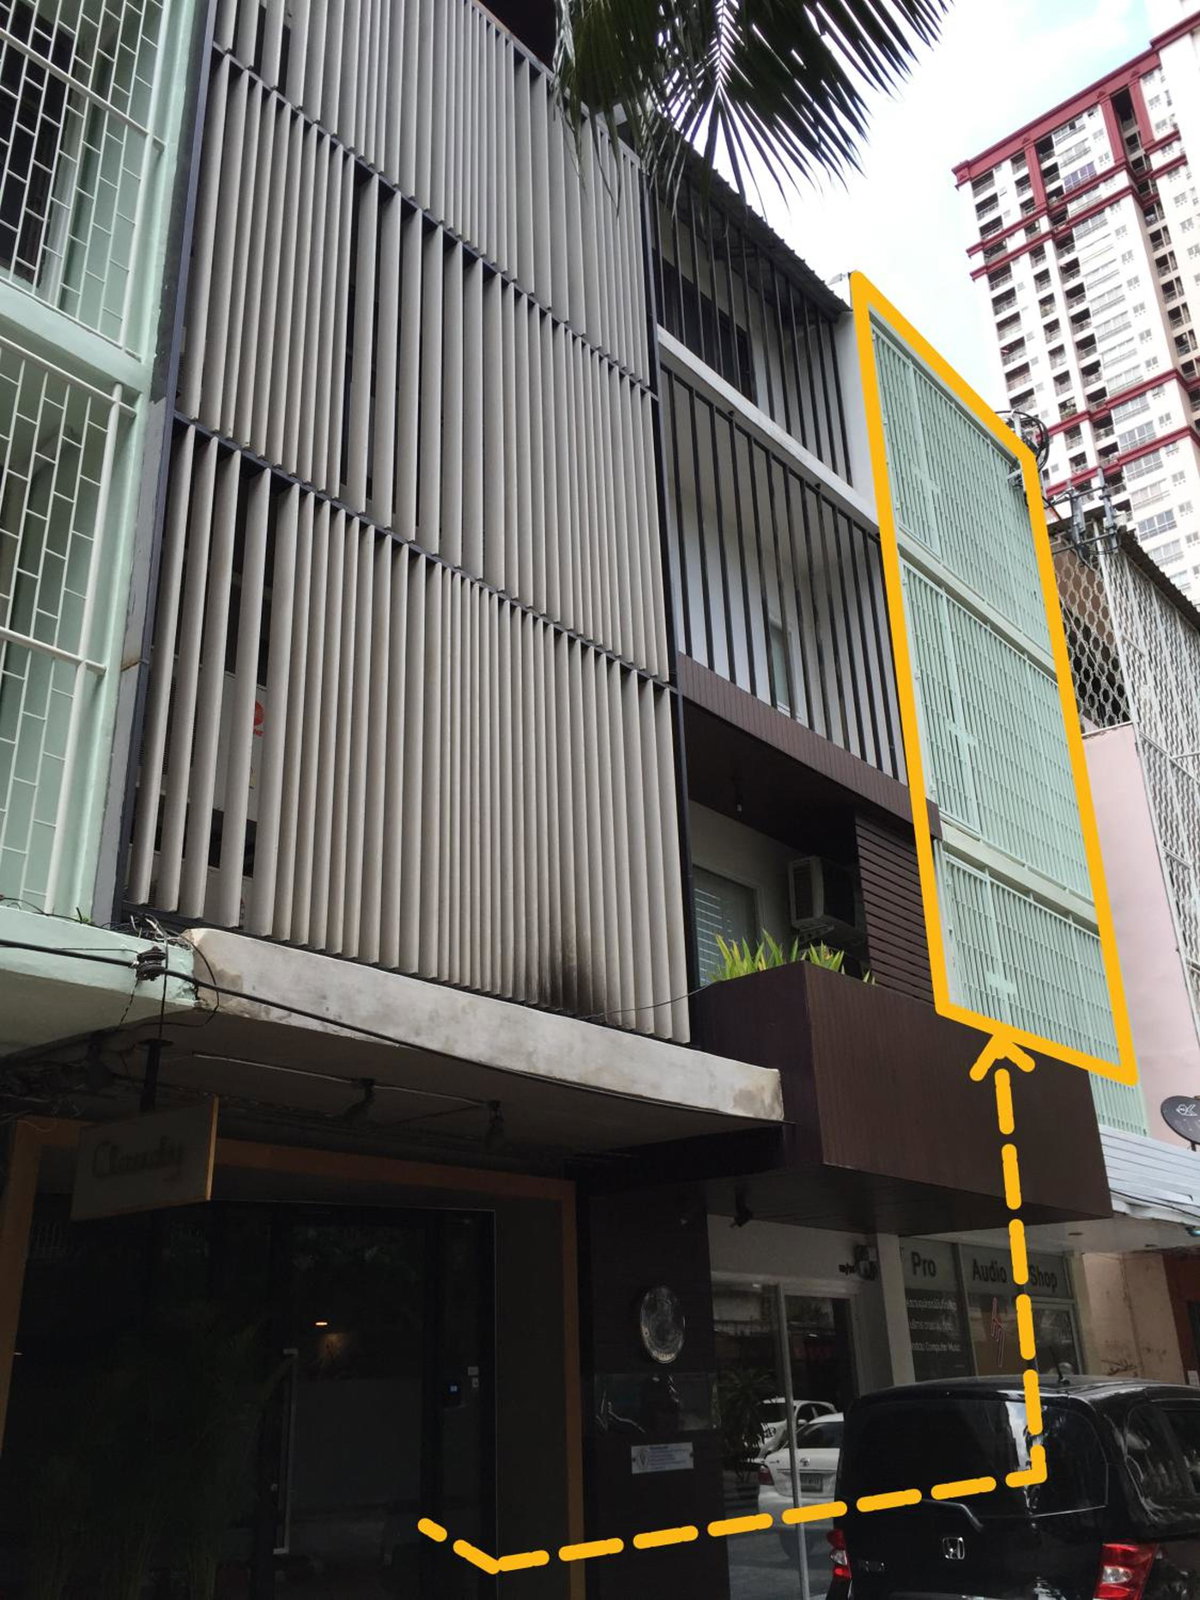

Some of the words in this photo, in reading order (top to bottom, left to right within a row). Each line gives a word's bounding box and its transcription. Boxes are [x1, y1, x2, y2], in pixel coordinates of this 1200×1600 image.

[911, 1251, 937, 1278] Pro
[973, 1260, 1007, 1283] Audio
[1029, 1265, 1058, 1292] Shop
